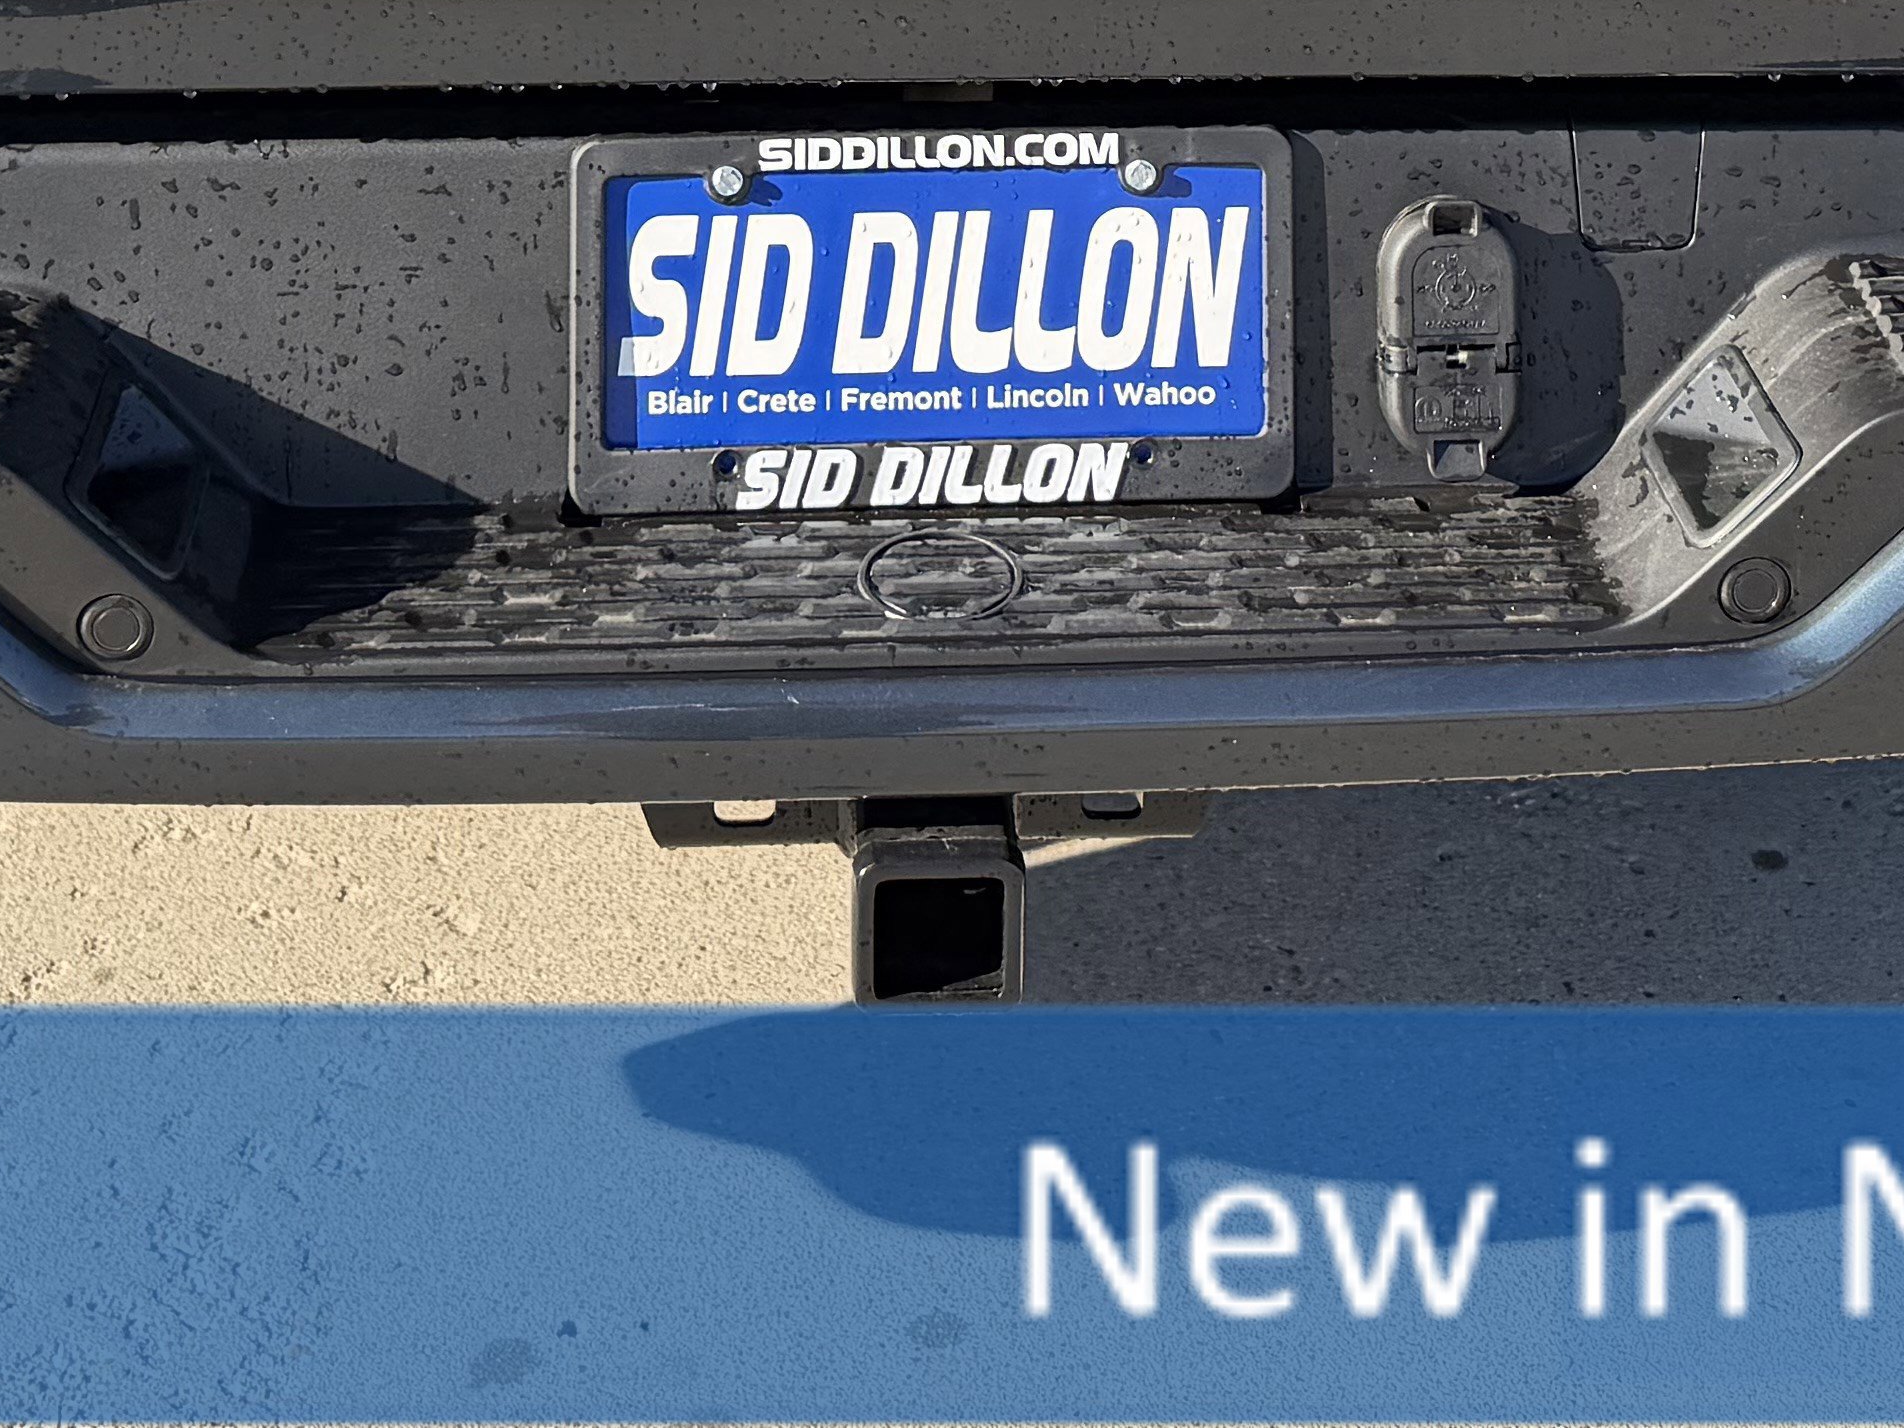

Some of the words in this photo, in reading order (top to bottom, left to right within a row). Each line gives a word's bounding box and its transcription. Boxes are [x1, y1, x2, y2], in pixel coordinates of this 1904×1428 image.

[758, 132, 1119, 171] SIDDILLON.COM
[618, 214, 814, 377] SID
[831, 206, 1250, 375] DILLON
[647, 389, 713, 415] Blair
[737, 389, 817, 414] Crete
[841, 386, 962, 412] Fremont
[987, 383, 1089, 410] Lincoln
[1114, 382, 1216, 407] Wahoo
[736, 448, 856, 510] SID
[869, 442, 1130, 508] DILLON
